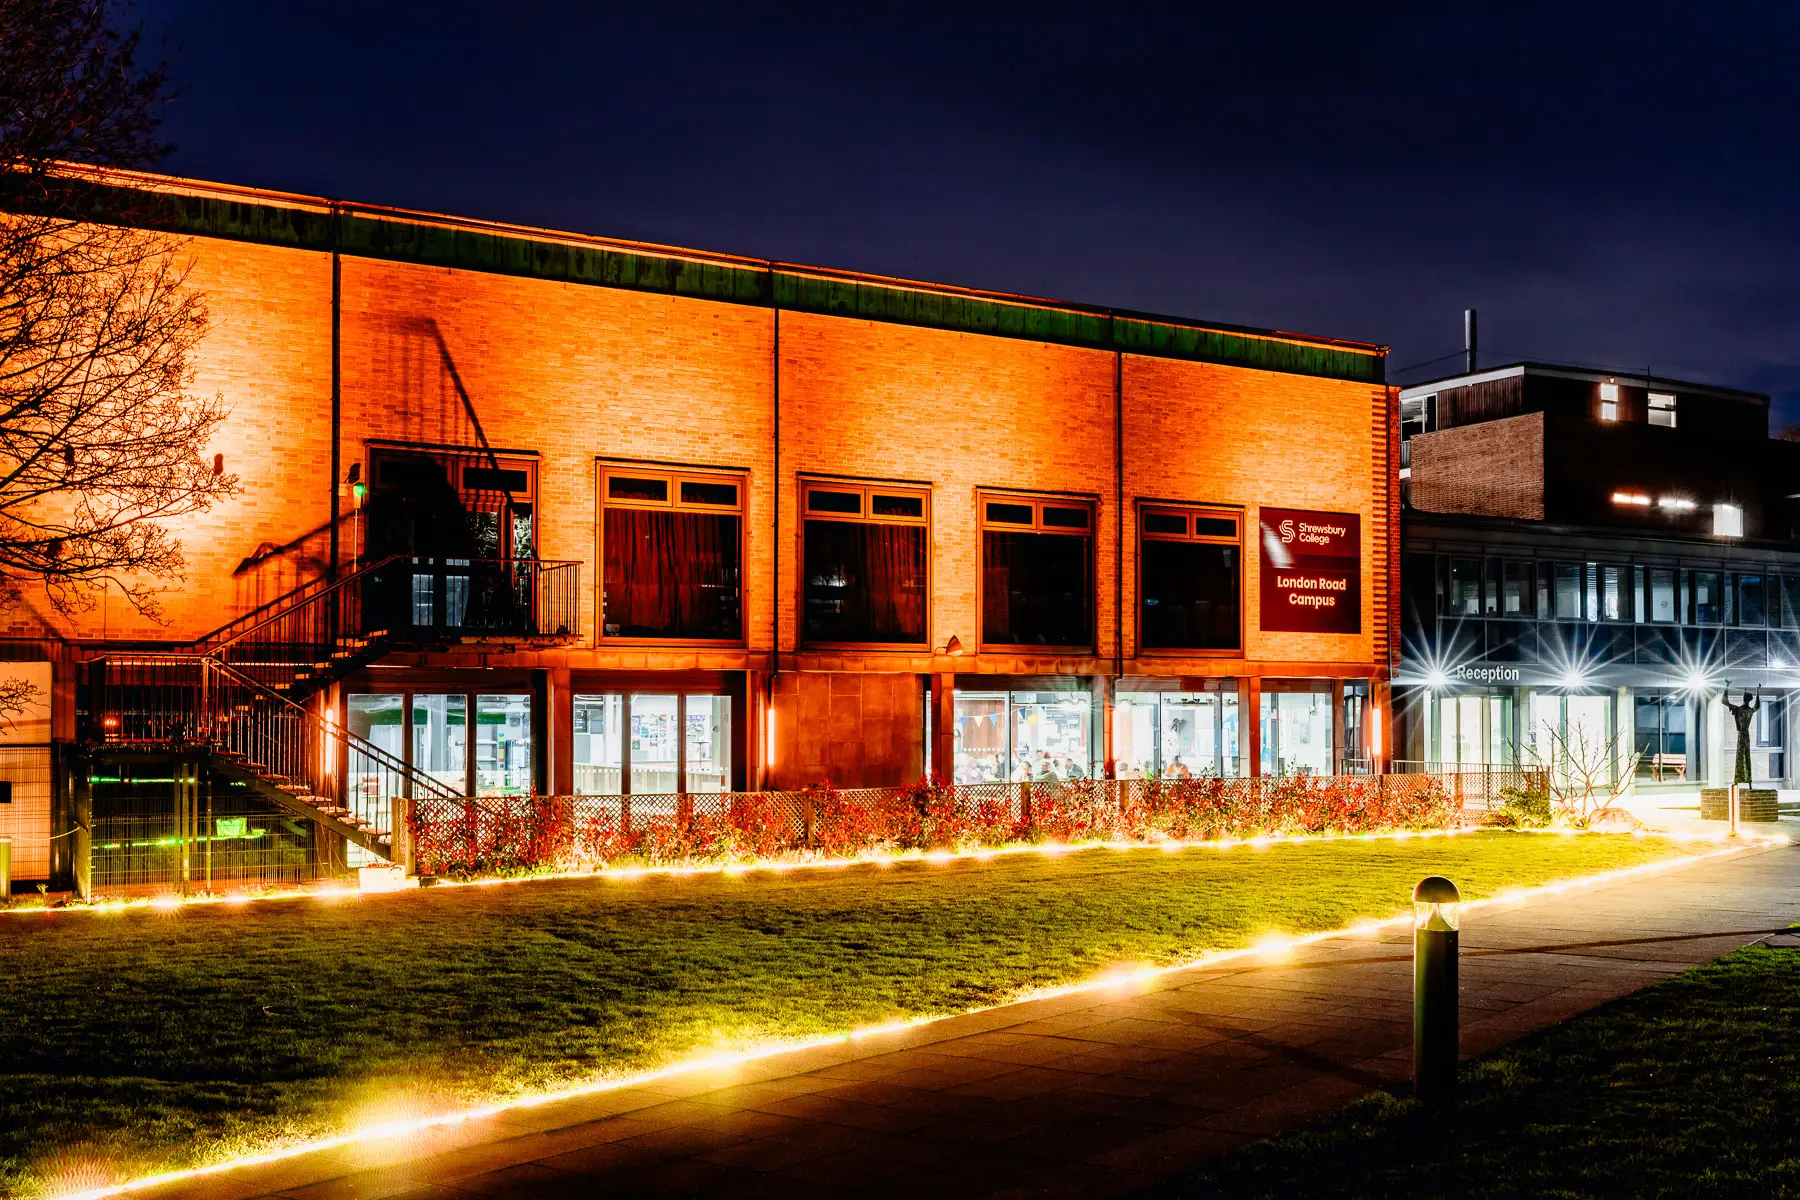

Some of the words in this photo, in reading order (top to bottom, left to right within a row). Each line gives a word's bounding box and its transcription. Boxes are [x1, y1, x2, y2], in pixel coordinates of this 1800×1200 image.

[1299, 522, 1346, 537] Shrewsbury
[1299, 533, 1330, 545] College
[1277, 576, 1317, 589] London
[1319, 578, 1347, 590] Road
[1289, 593, 1336, 609] Campus
[1456, 664, 1519, 684] Reception
